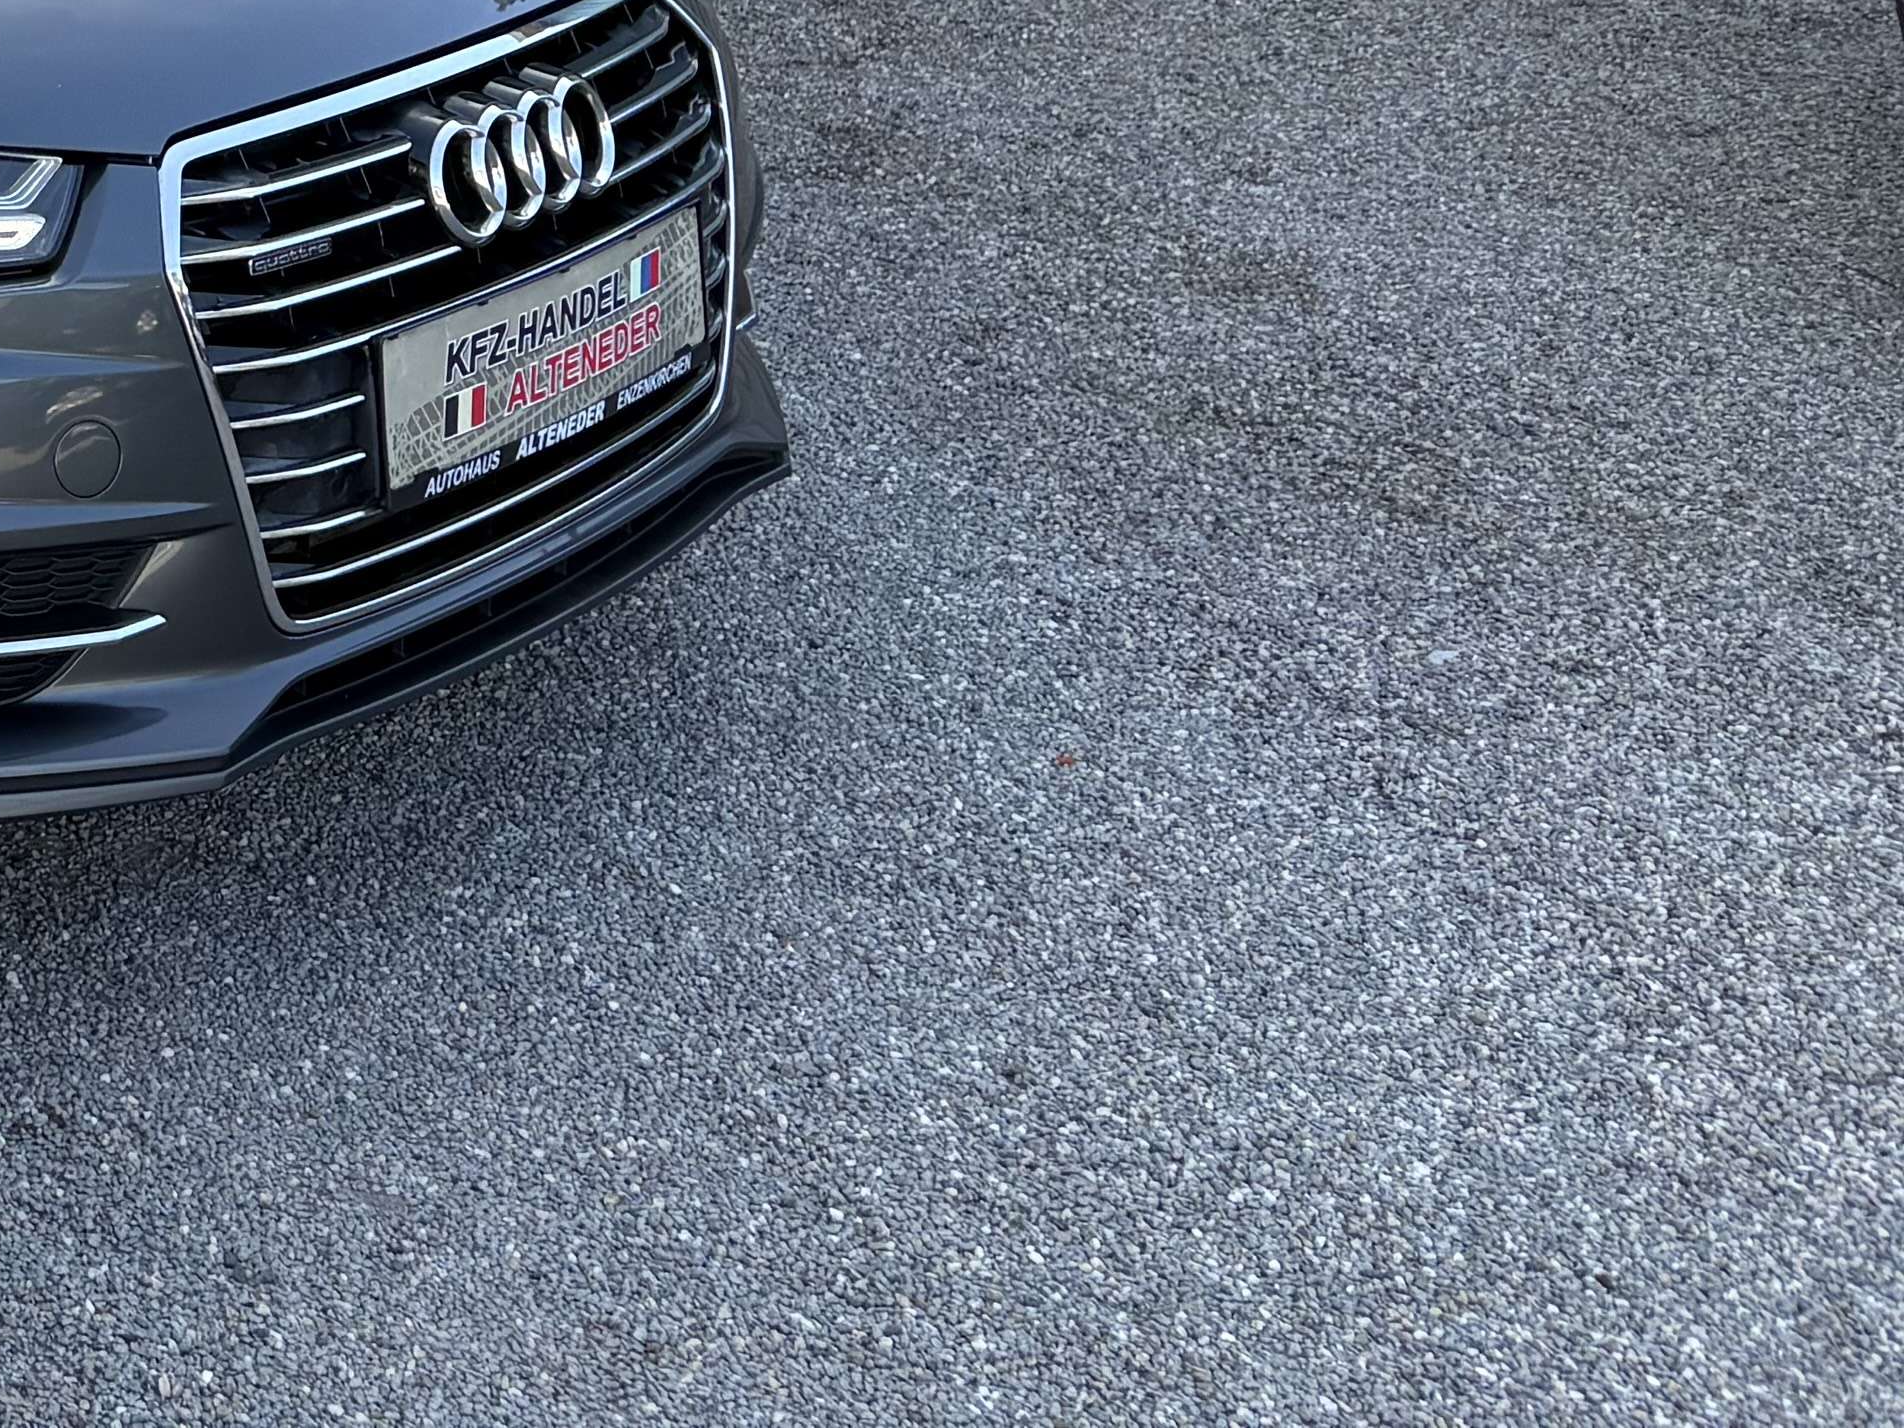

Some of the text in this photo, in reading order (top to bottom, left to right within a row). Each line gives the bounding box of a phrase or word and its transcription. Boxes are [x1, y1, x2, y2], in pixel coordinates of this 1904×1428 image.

[254, 241, 330, 274] quattro
[444, 271, 627, 385] KFZ-HANDEL
[504, 302, 661, 415] ALTENEDER
[424, 351, 692, 498] AUTOHAUS ALTENEDER ENZENKIRCHEN
